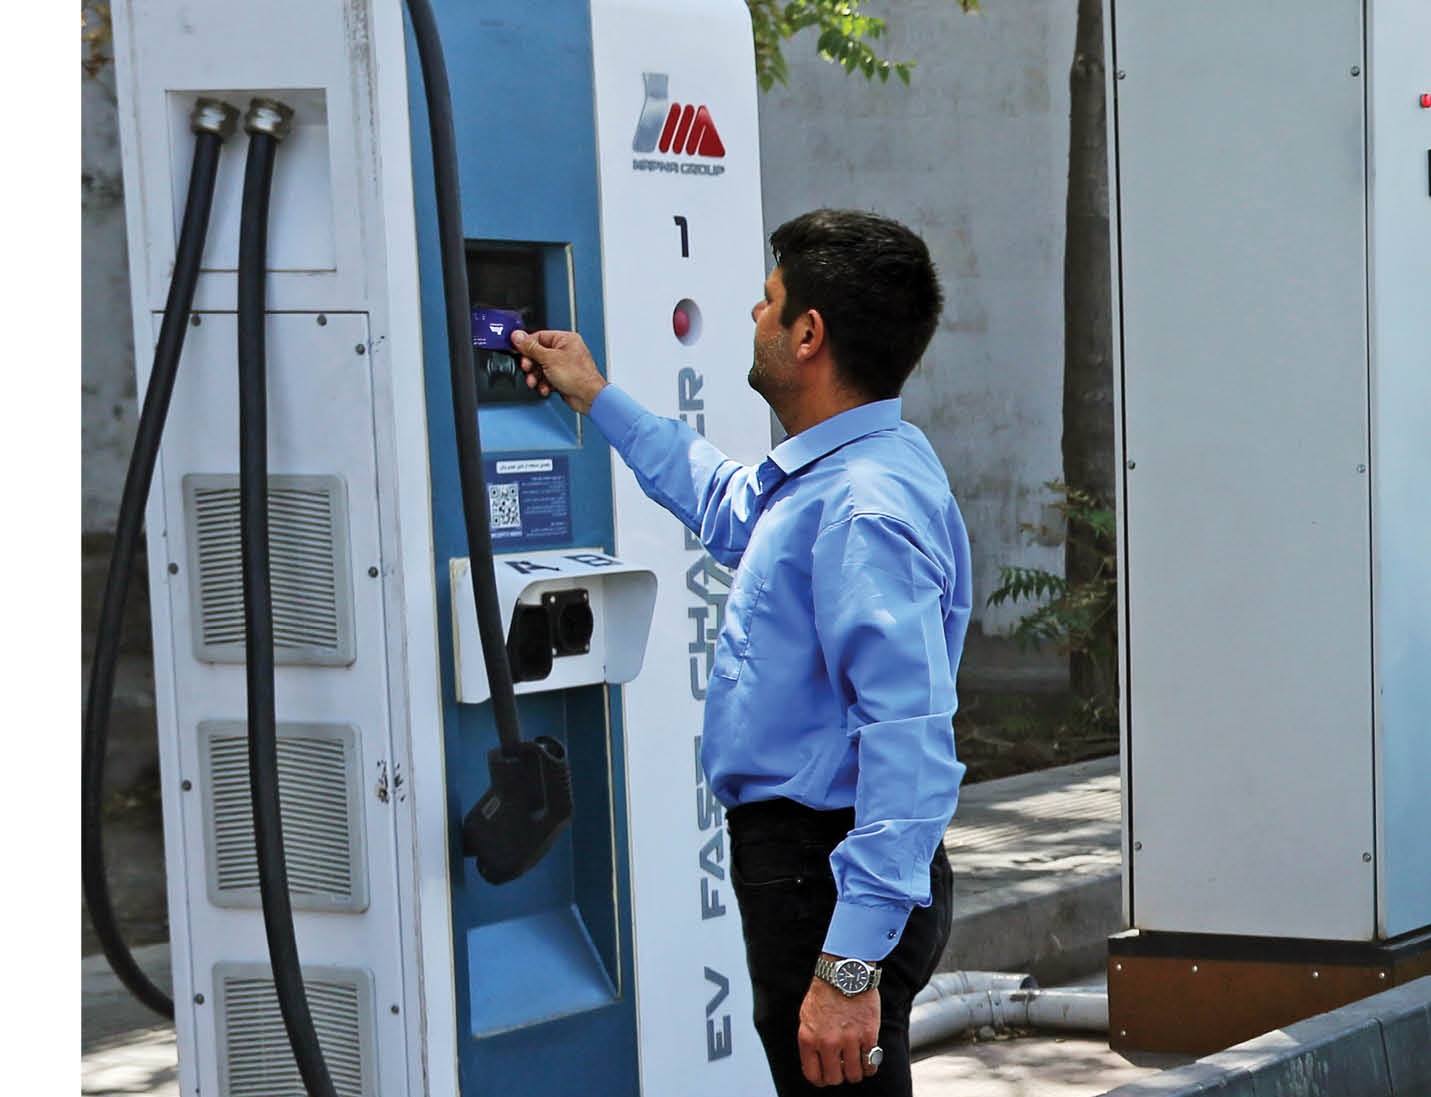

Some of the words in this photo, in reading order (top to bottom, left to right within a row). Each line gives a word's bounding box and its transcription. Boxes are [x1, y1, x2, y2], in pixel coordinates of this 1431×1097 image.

[680, 163, 725, 176] GROUP
[673, 215, 689, 258] 1
[703, 966, 733, 1062] EV
